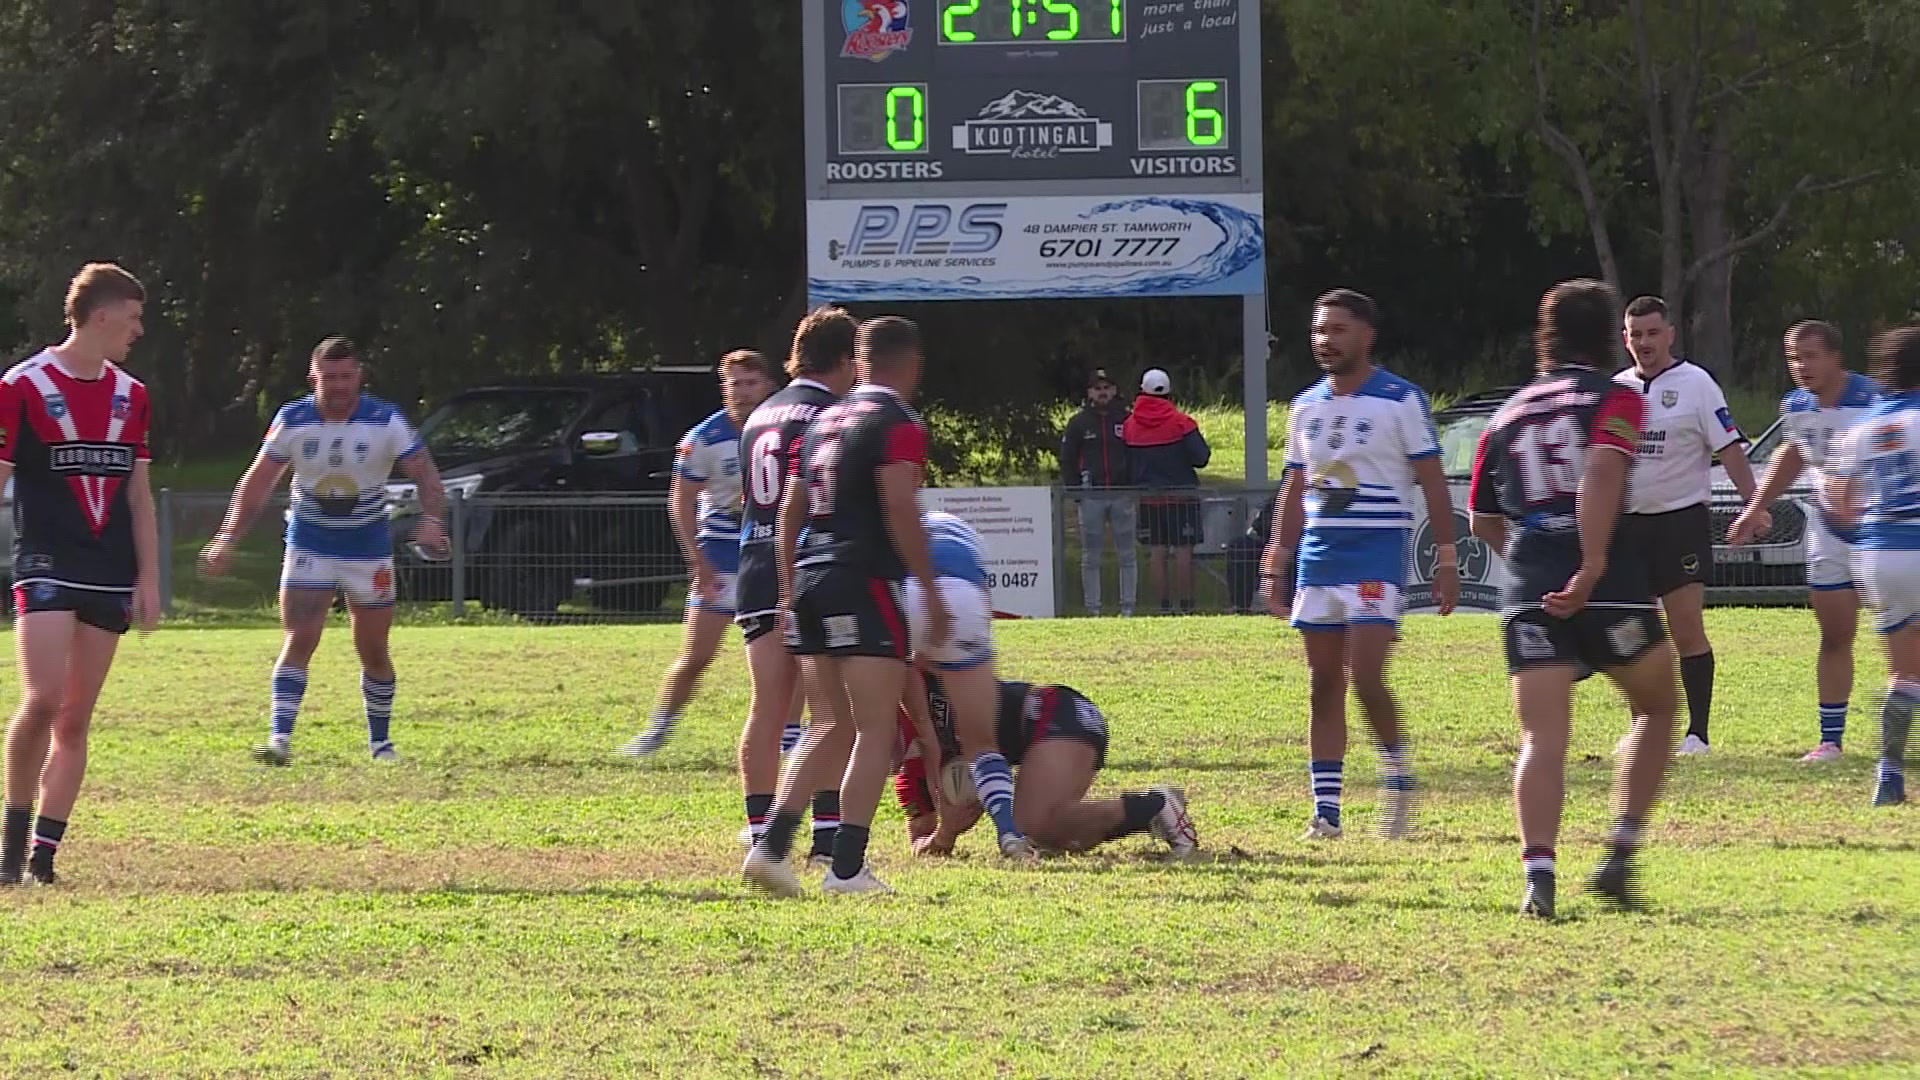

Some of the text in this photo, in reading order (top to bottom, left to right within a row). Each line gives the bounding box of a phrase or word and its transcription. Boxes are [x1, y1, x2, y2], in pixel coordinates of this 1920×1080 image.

[1143, 3, 1184, 16] more
[1140, 11, 1237, 39] just a local
[886, 87, 923, 150] 0
[1186, 81, 1222, 145] 6
[974, 126, 1090, 146] KOOTINGAL
[1011, 146, 1059, 159] hotel
[826, 161, 943, 179] ROOSTERS
[1130, 156, 1236, 175] VISITORS
[846, 203, 1007, 255] PPS
[1023, 222, 1192, 234] 48 DAMPIER ST. TAMWORTH
[1039, 237, 1181, 258] 6701 7777
[841, 256, 997, 269] PUMPS & PIPELINE SERVICES
[751, 428, 784, 507] 6
[1508, 414, 1586, 502] 13
[1002, 572, 1039, 589] 0487
